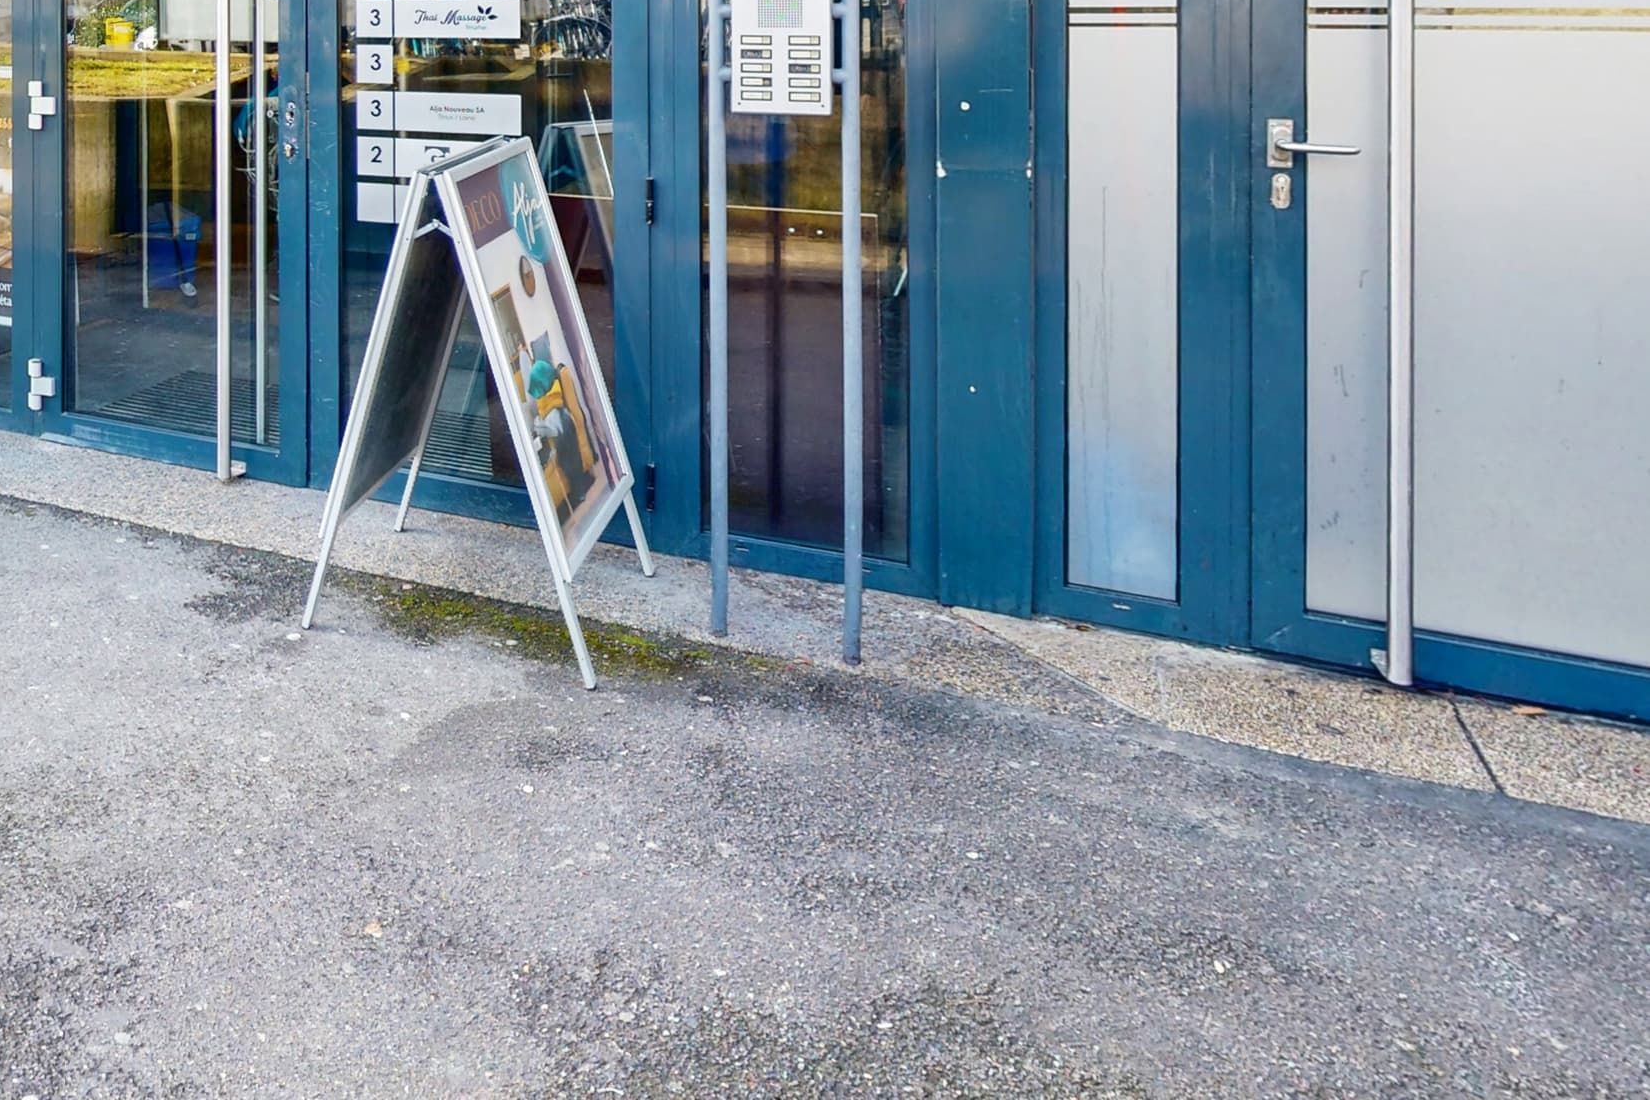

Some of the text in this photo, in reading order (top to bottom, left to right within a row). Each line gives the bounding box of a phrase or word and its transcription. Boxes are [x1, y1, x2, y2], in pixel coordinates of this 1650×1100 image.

[370, 9, 487, 26] 3 Thai Massage
[370, 53, 382, 71] 3
[370, 99, 382, 117] 3
[371, 146, 382, 163] 2
